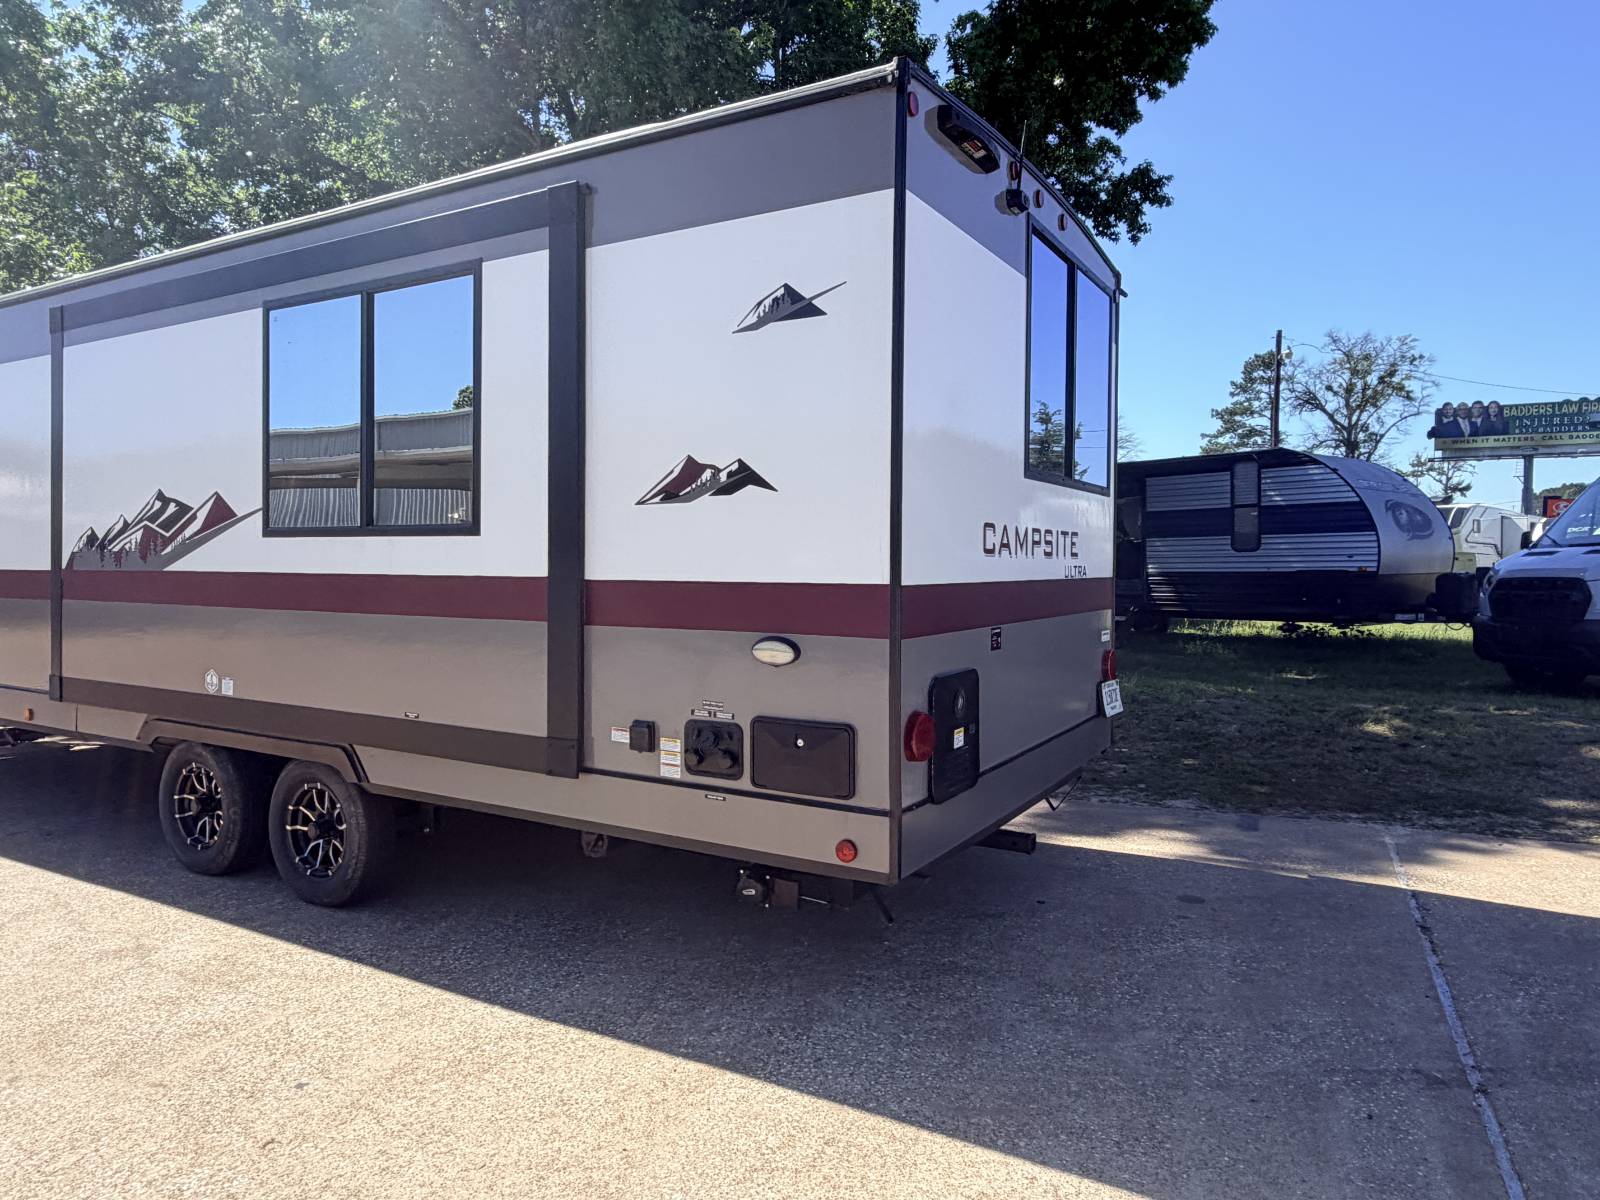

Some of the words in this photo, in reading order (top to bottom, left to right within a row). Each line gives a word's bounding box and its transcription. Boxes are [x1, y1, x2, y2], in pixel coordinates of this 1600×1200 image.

[1503, 404, 1553, 417] BADDERS
[1555, 402, 1579, 414] LAW
[1582, 401, 1600, 413] FIR
[1515, 416, 1590, 427] INJURED?
[983, 522, 1079, 559] CAMPSITE
[1064, 565, 1087, 578] ULTRA
